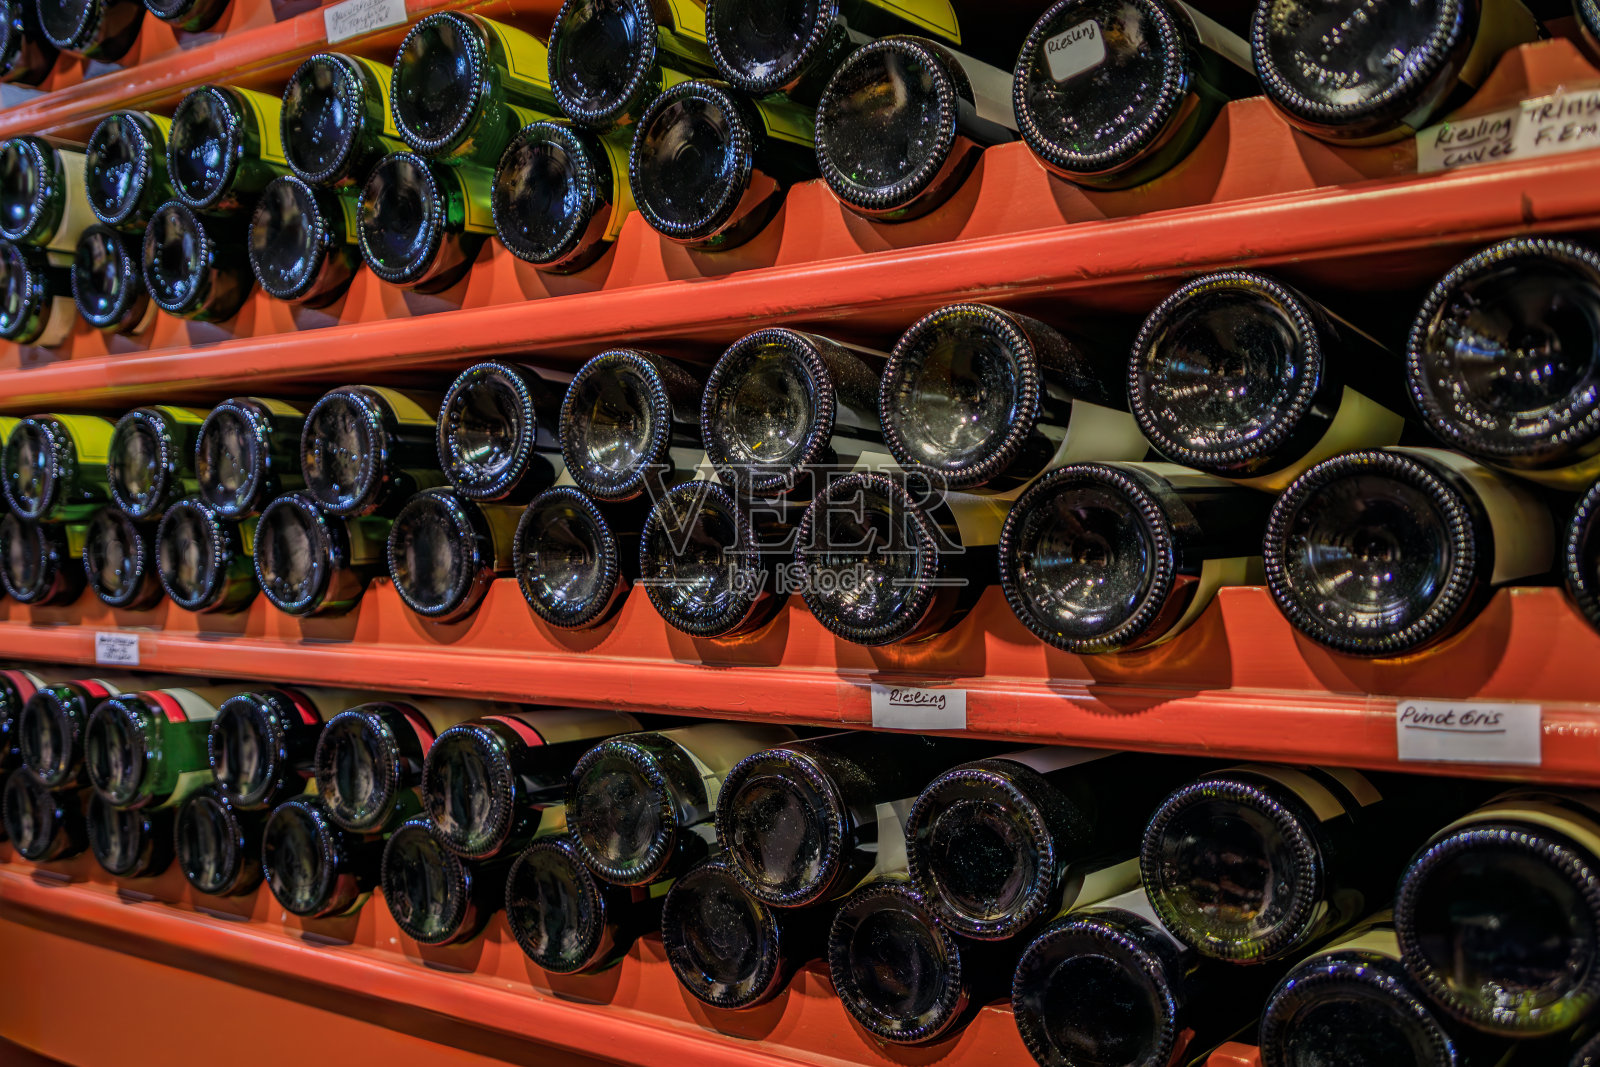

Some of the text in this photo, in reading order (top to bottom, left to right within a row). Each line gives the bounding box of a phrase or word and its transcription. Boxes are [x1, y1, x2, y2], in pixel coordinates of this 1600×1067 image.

[1047, 23, 1095, 54] Riesling
[1434, 118, 1513, 148] Riesling
[889, 688, 947, 710] Riesling
[1400, 706, 1504, 726] Pinot Gris
